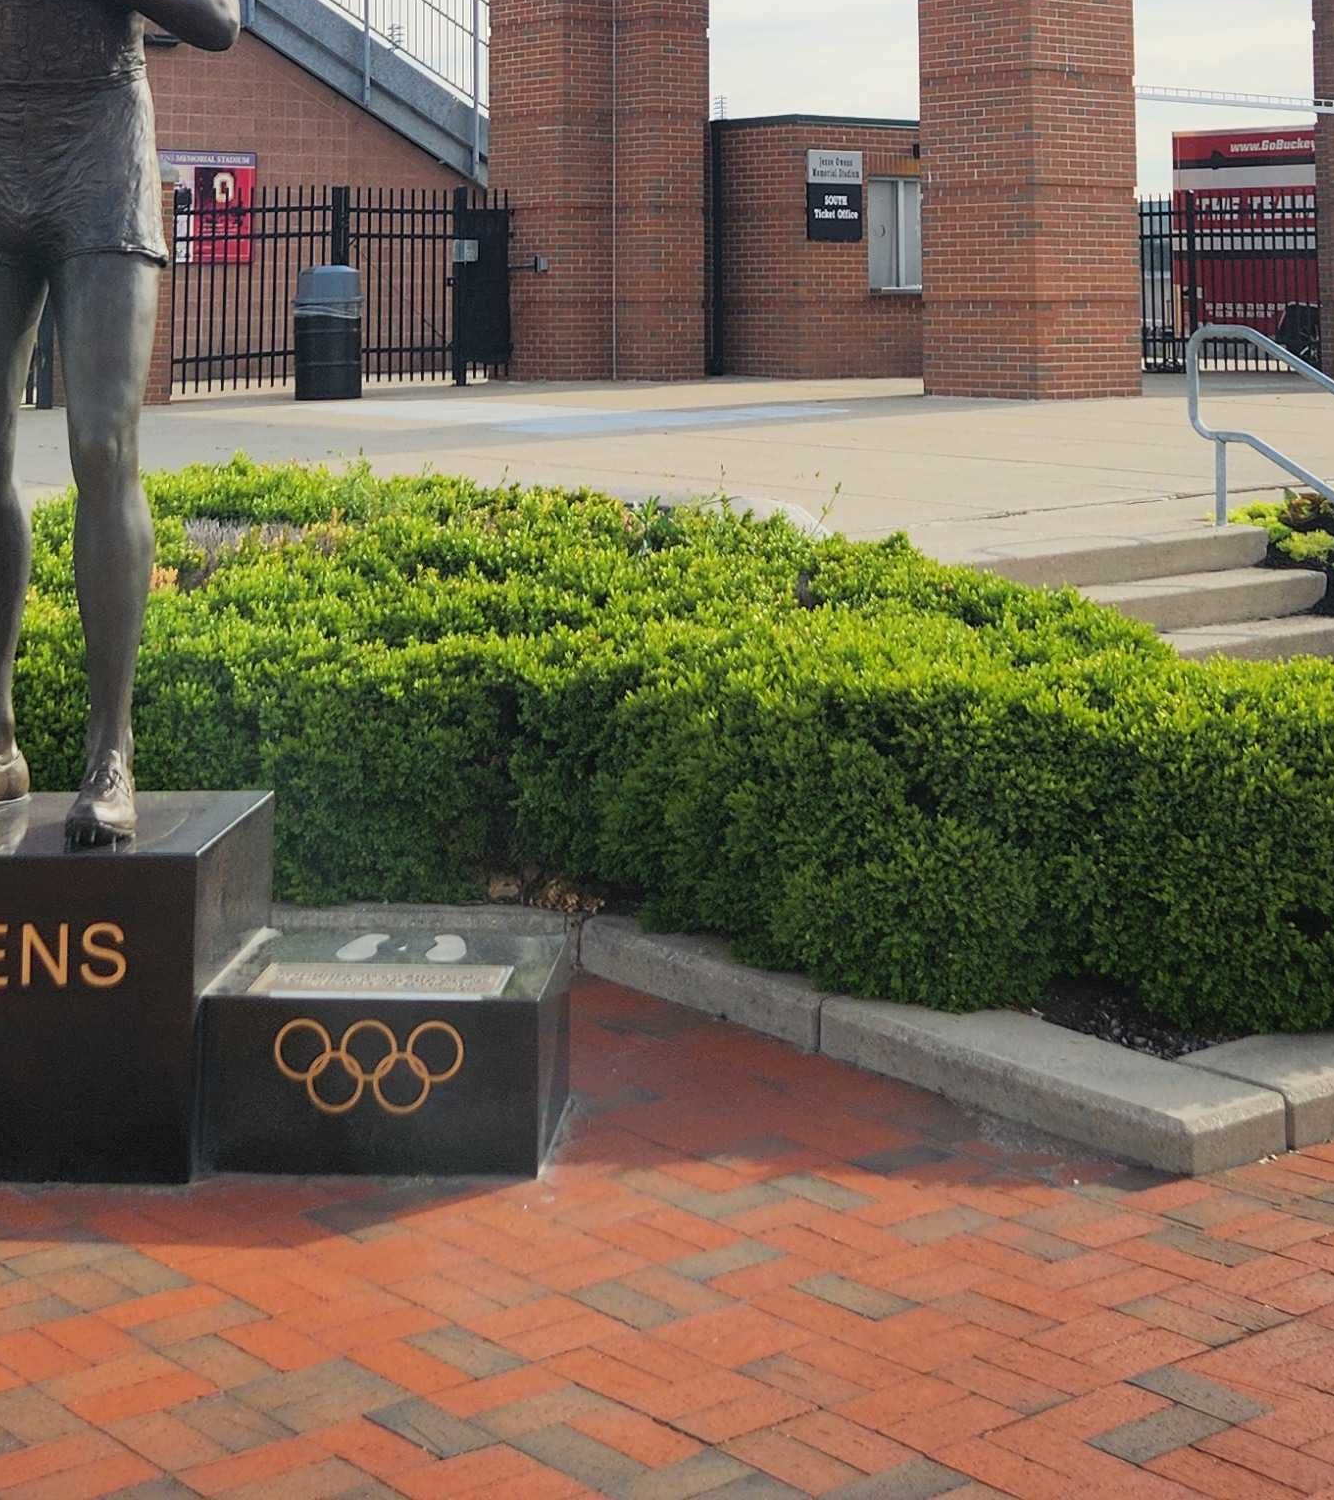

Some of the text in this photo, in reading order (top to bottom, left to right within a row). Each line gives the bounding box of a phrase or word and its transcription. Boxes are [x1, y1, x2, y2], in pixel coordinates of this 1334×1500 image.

[175, 154, 216, 164] MEMORIAL
[217, 156, 250, 165] STADIUM
[825, 195, 848, 205] SOUTH
[814, 209, 858, 219] Ticket Office
